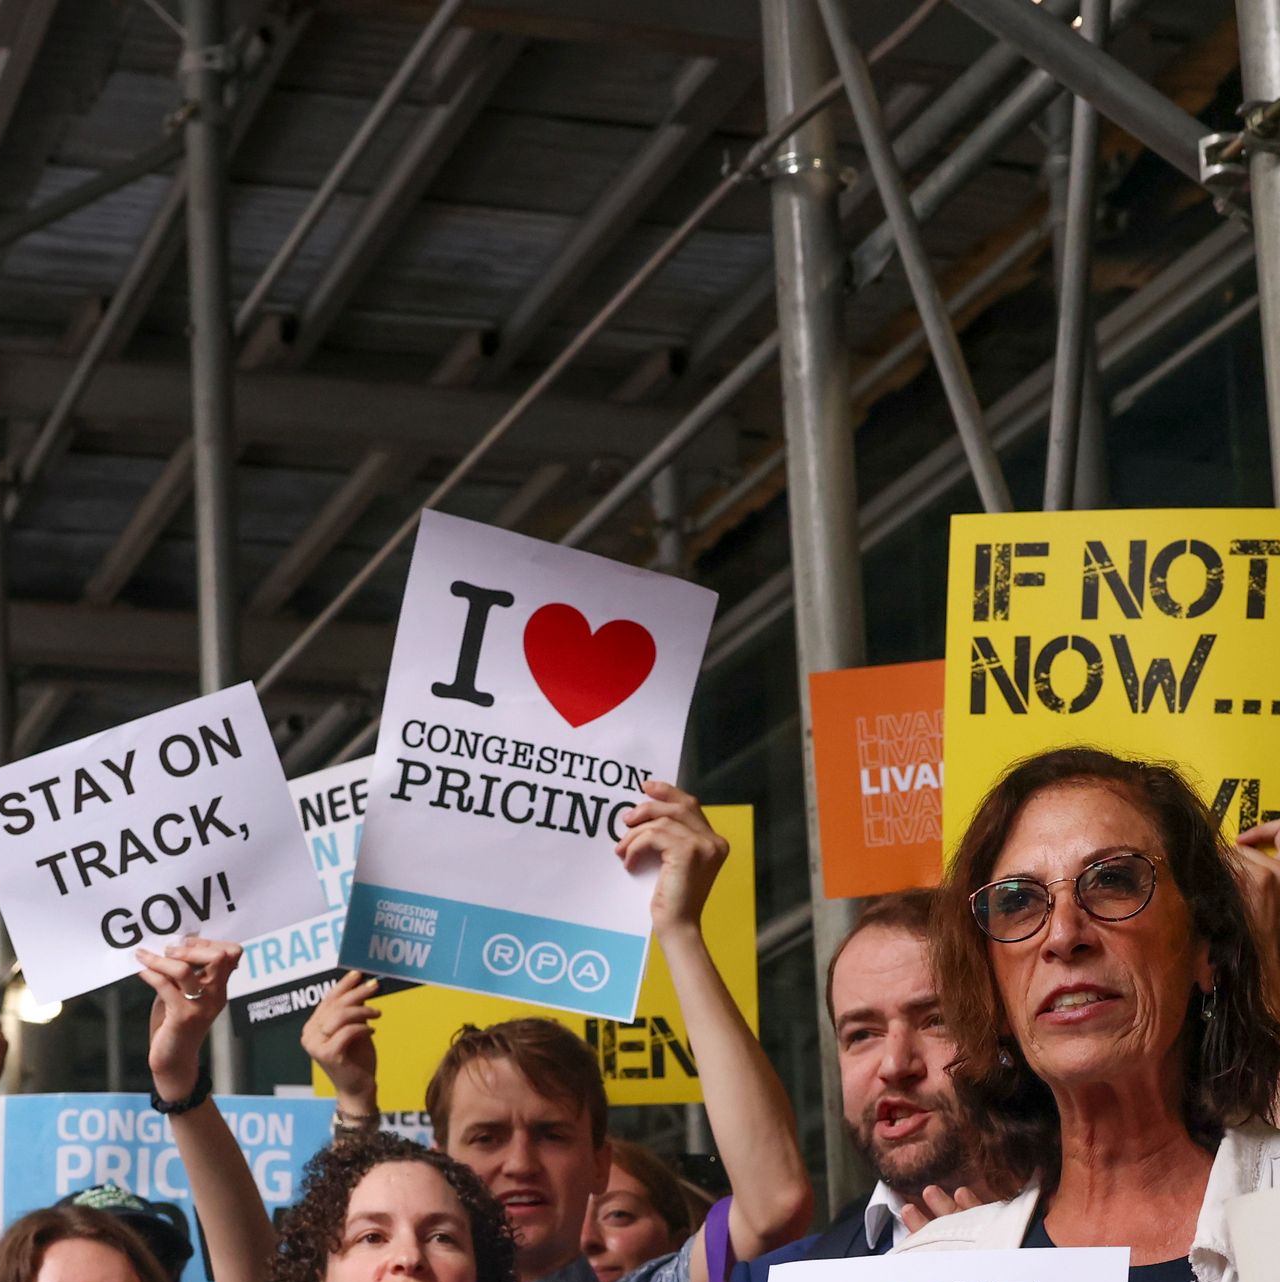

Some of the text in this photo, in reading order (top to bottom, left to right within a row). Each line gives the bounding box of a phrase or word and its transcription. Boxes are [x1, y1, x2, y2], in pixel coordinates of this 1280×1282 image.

[973, 542, 1049, 622] IF
[431, 580, 515, 707] I
[856, 710, 944, 742] LIVA
[159, 717, 242, 778] ON
[402, 720, 652, 794] CONGESTION
[858, 736, 944, 768] LIVA
[861, 762, 944, 795] LIVA
[299, 779, 368, 831] NEE
[862, 788, 943, 821] LIVA
[36, 796, 250, 896] TRACK,
[865, 815, 943, 848] LIVA
[101, 871, 236, 949] GOV!
[374, 911, 436, 937] PRICING
[376, 900, 438, 920] CONGESTION
[368, 935, 432, 968] NOW
[57, 1108, 294, 1145] CONGION
[56, 1144, 292, 1201] PRICG
